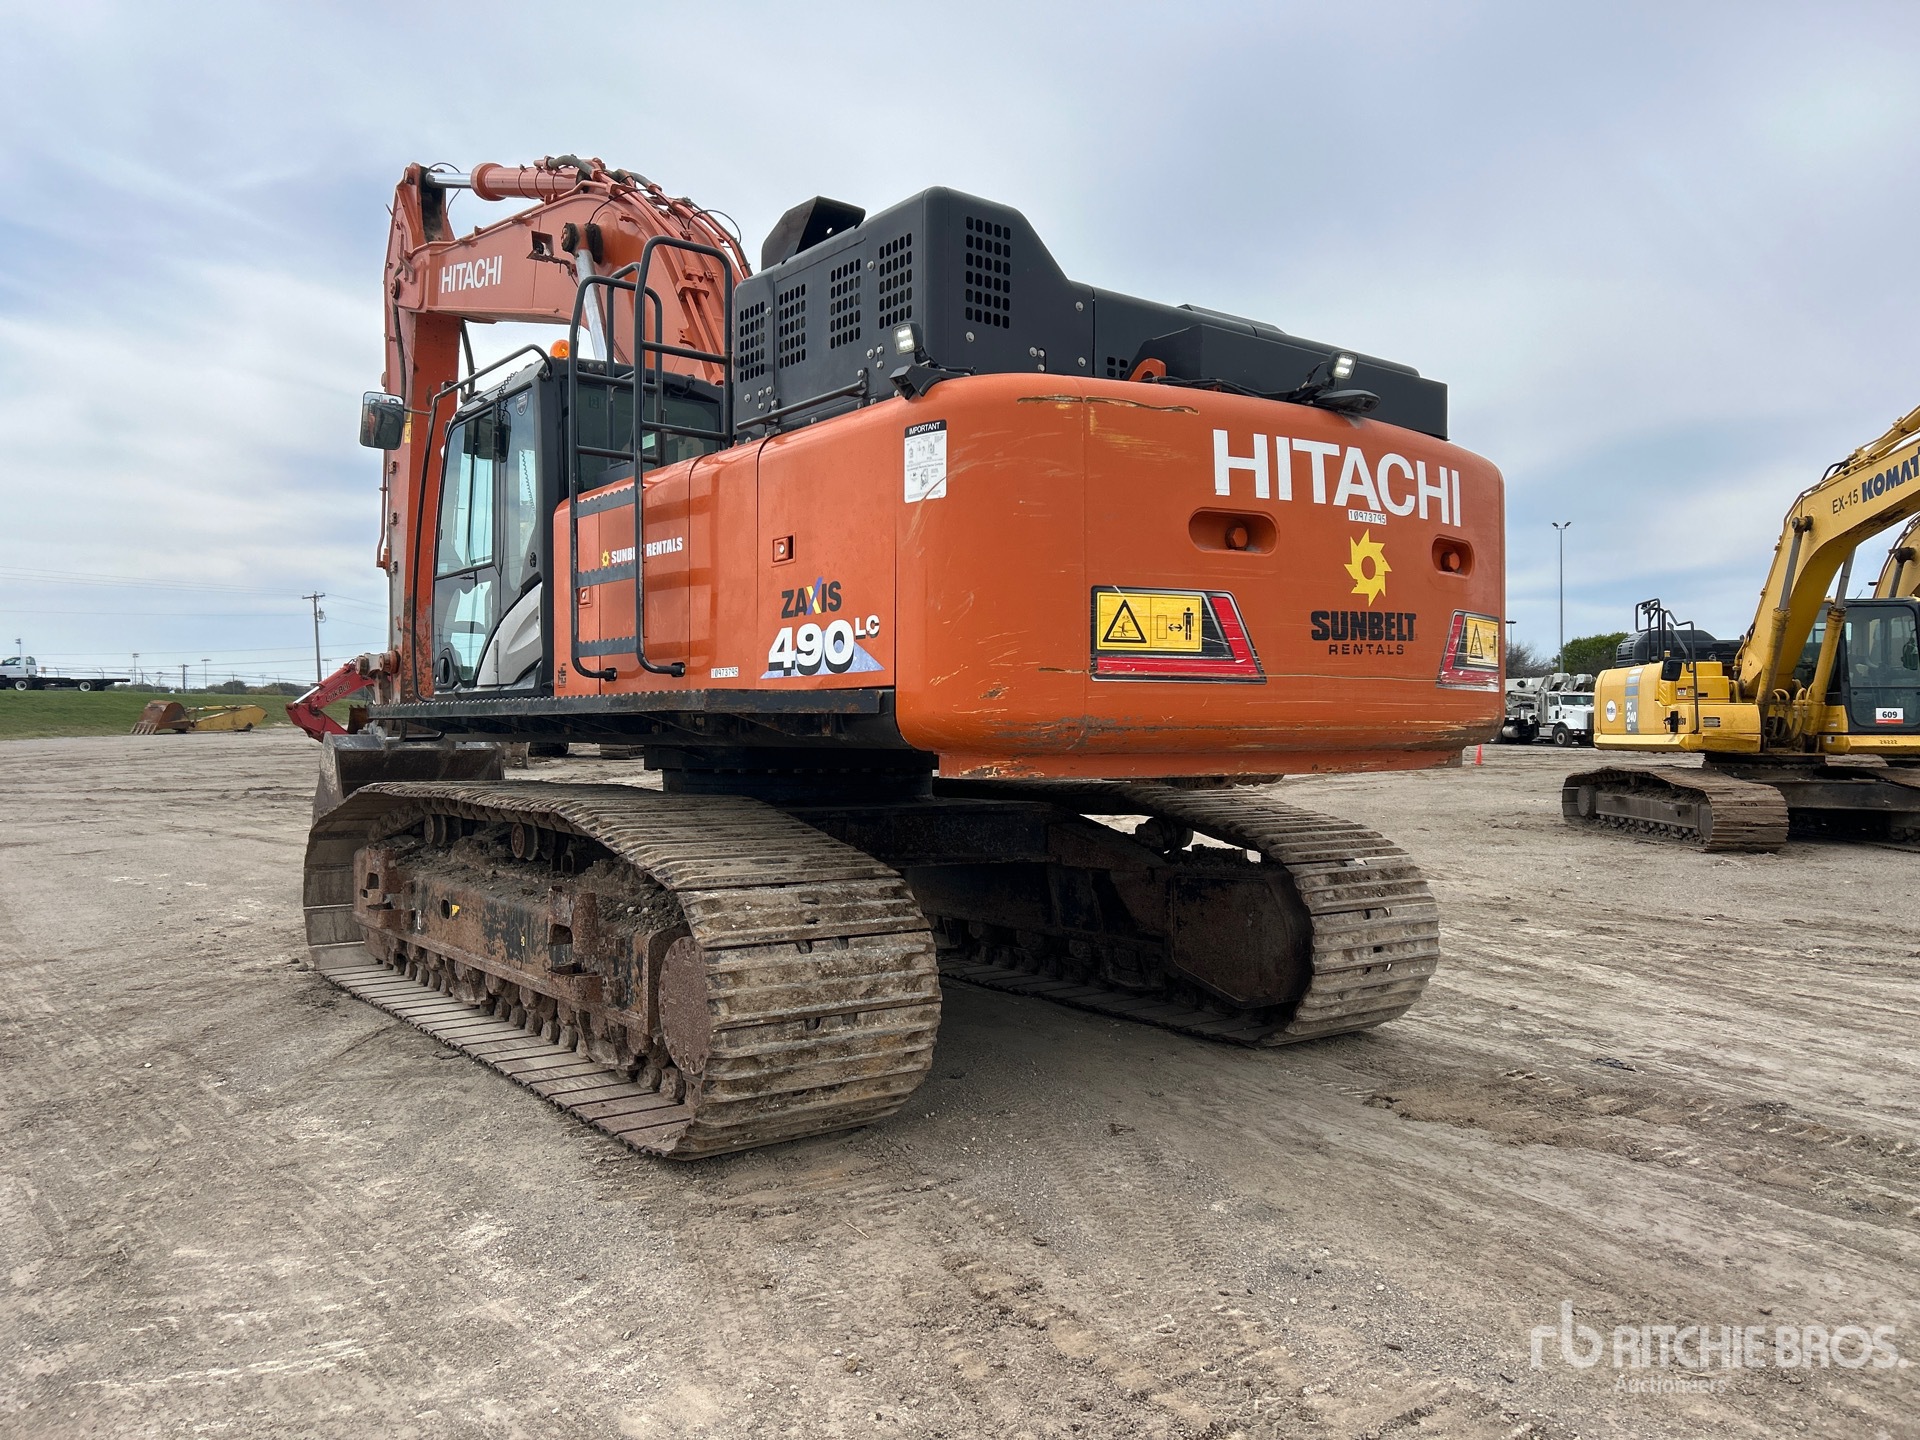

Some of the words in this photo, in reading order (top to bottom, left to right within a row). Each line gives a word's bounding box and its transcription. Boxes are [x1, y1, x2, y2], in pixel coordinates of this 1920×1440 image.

[441, 255, 503, 294] HITACHI
[908, 421, 941, 435] IMPORTANT
[1213, 429, 1461, 527] HITACHI
[1832, 489, 1859, 514] EX-15
[1349, 510, 1386, 524] 10973795
[611, 544, 645, 564] SUNB
[646, 536, 683, 557] RENTALS
[781, 576, 842, 619] ZAXIS
[1310, 610, 1417, 641] SUNBELT
[1328, 644, 1404, 655] RENTALS
[1882, 711, 1898, 719] 609
